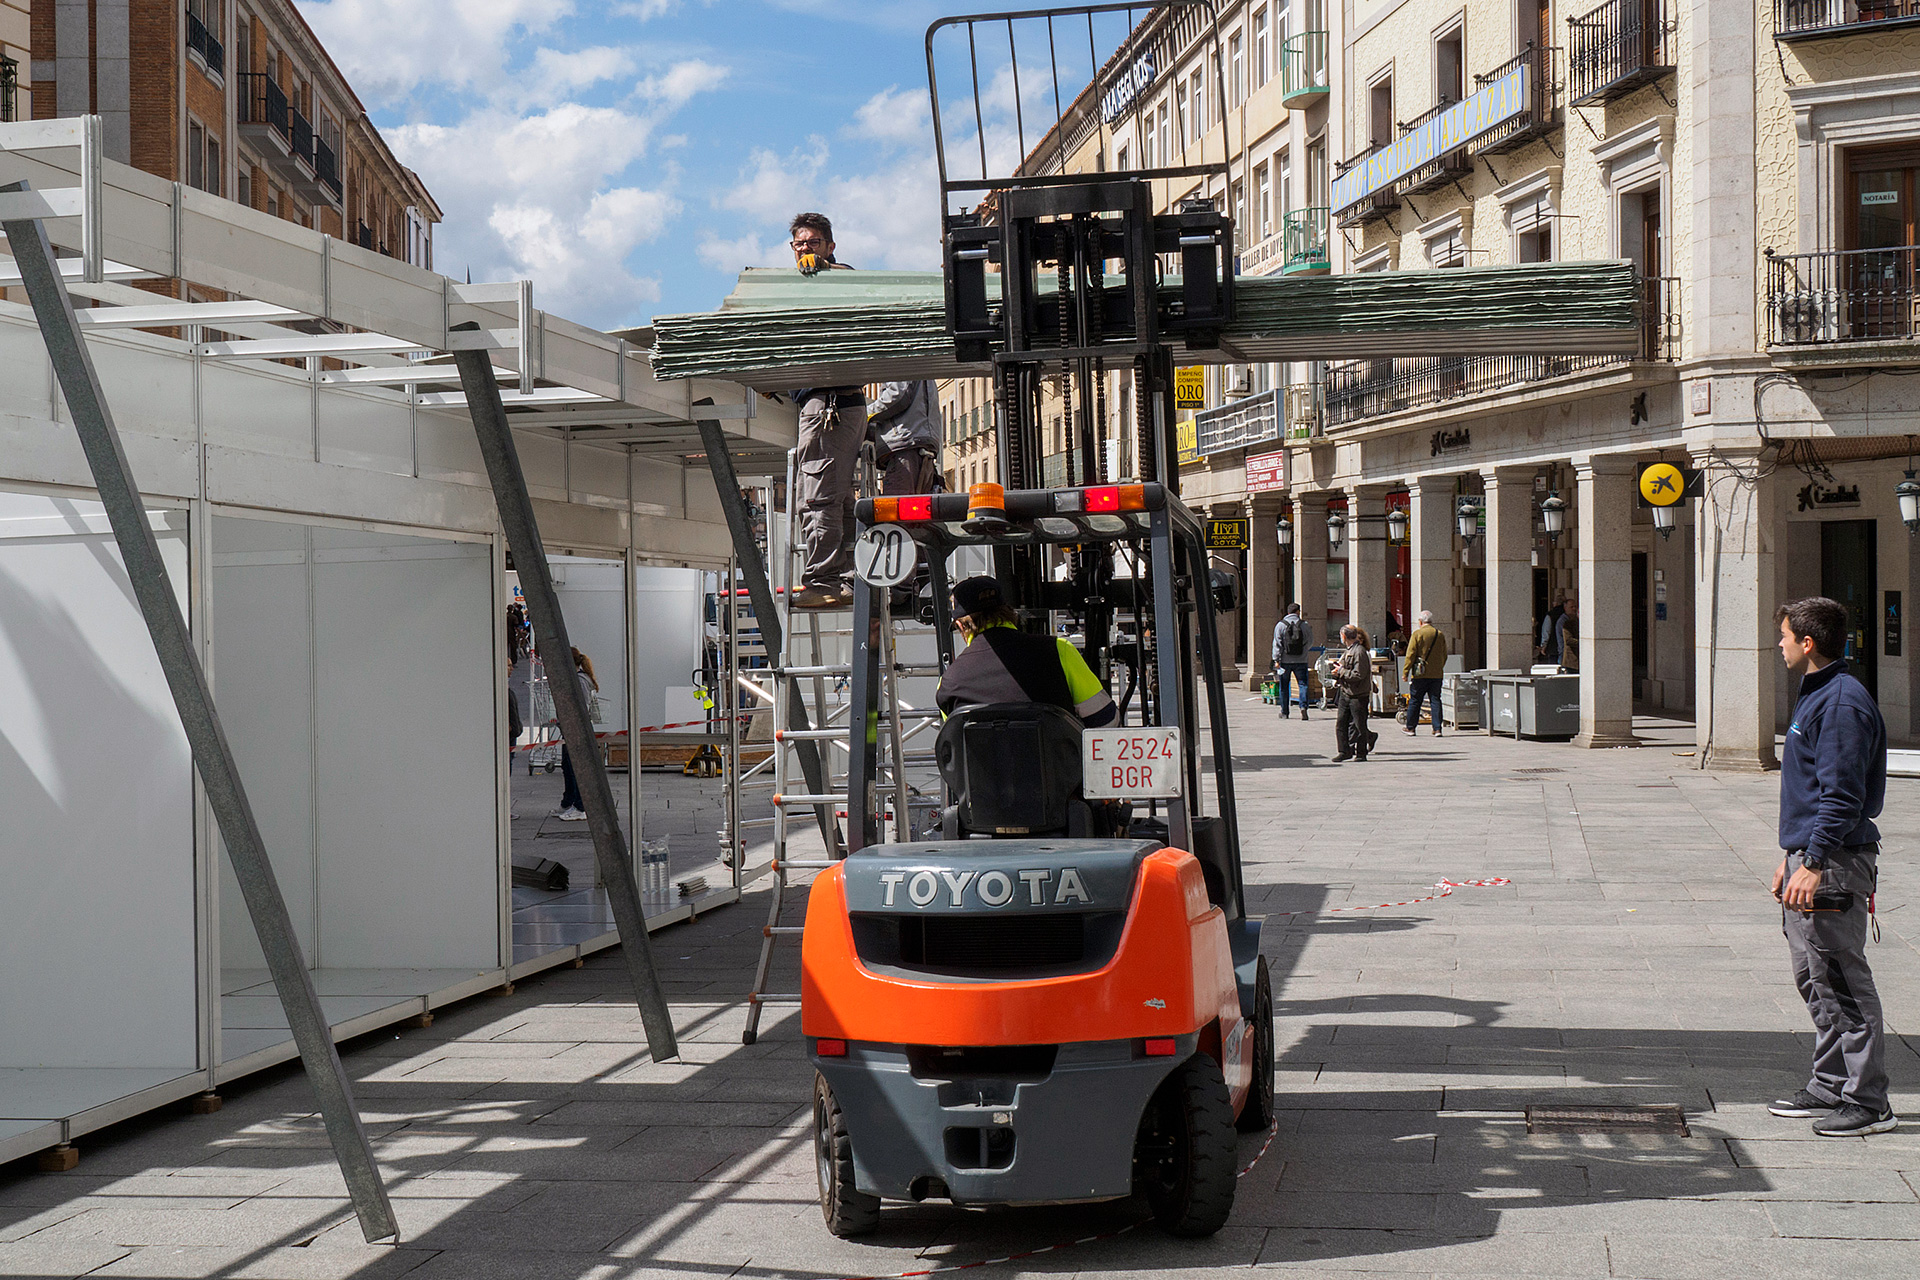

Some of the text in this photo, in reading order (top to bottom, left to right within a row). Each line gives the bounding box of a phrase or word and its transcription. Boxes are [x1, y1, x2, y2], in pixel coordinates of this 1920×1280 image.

[1102, 53, 1150, 126] AXA SEGUROS
[1332, 72, 1521, 212] AUTO-ESCUELA ALCAZAR
[1863, 193, 1895, 202] NOTARÍA
[1242, 249, 1260, 272] TALLER
[1261, 244, 1269, 262] DE
[1177, 384, 1204, 400] ORO
[1176, 424, 1190, 450] RO
[867, 530, 903, 580] 20
[1092, 737, 1173, 761] E 2524
[1111, 765, 1153, 788] BGR
[879, 868, 1093, 907] TOYOTA
